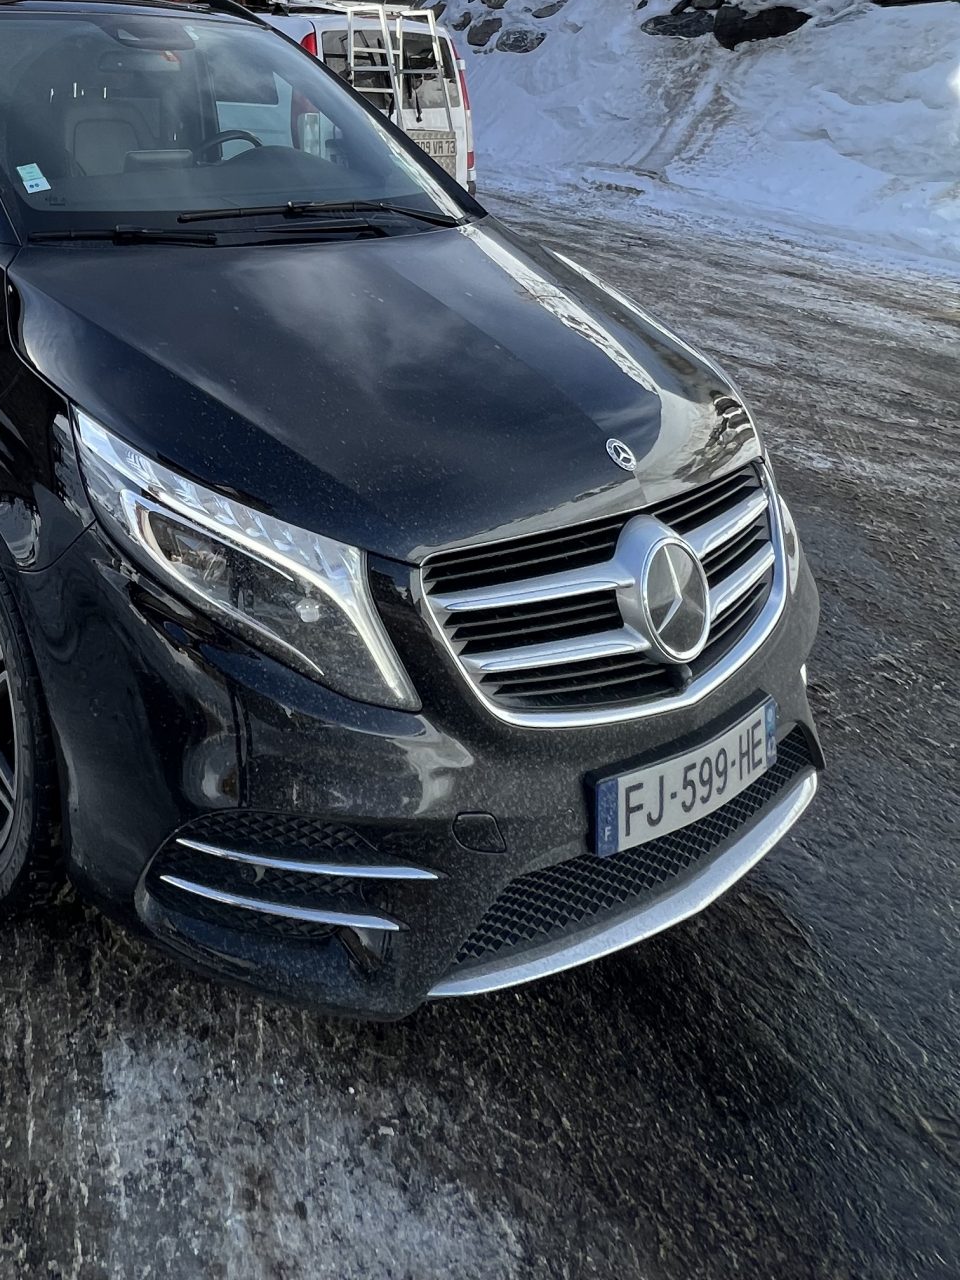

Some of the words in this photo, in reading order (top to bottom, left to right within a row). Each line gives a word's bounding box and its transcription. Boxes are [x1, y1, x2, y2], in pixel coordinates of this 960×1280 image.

[445, 140, 456, 155] 73
[624, 719, 763, 838] FJ-599-HE
[604, 825, 612, 842] F
